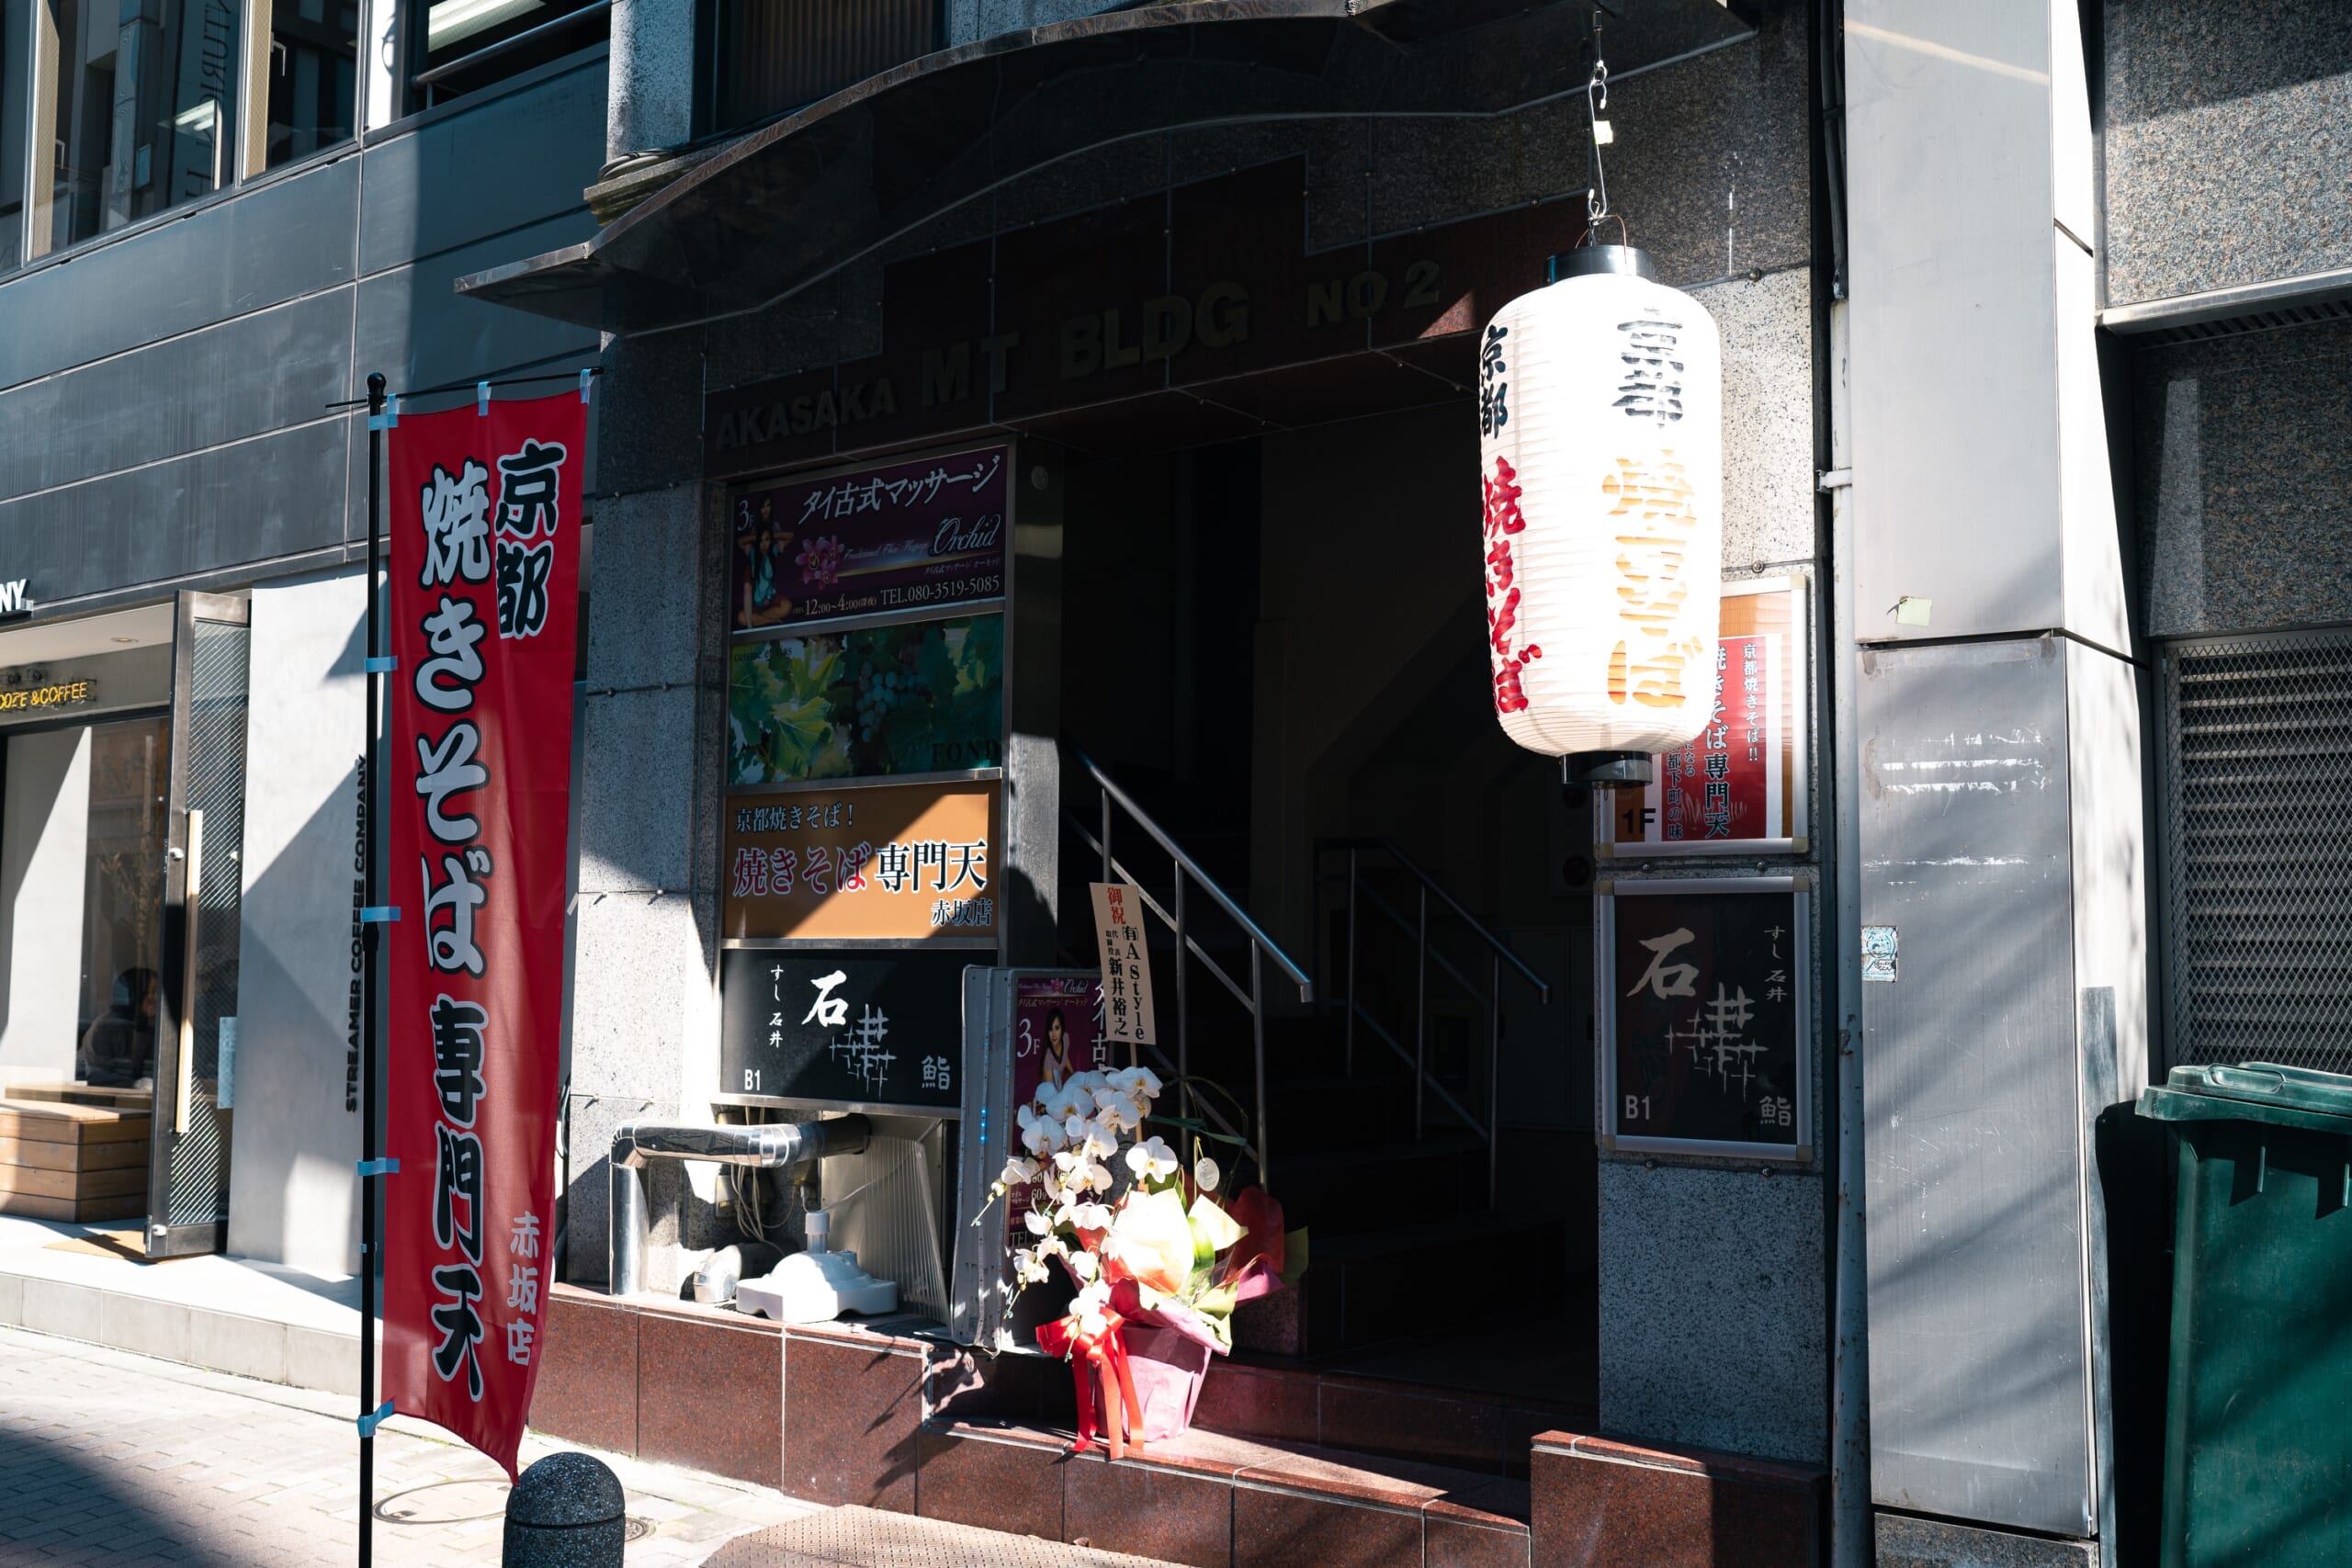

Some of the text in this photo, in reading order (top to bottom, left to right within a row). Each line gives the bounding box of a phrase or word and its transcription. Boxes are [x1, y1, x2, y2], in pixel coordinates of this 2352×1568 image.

[715, 259, 1441, 452] AKASAKA MT BLDG NO 2
[797, 454, 1001, 526] タイ古式マッサージ
[495, 437, 567, 640] 京都
[928, 513, 1002, 557] Orchid
[880, 574, 1001, 606] TEL.080-3519-5085
[1667, 746, 1684, 840] 都下町の味
[1623, 808, 1656, 834] 1F
[732, 838, 989, 898] 焼きそば専門天
[930, 898, 993, 927] 赤坂店
[1107, 886, 1126, 926] 御祝
[345, 979, 360, 1112] STREAMER
[1017, 1017, 1040, 1058] 3F
[744, 1068, 761, 1091] B1
[922, 1055, 951, 1091] 鮨
[1624, 1095, 1652, 1120] B1
[1759, 1095, 1792, 1127] 鮨
[507, 1210, 540, 1368] 赤坂店
